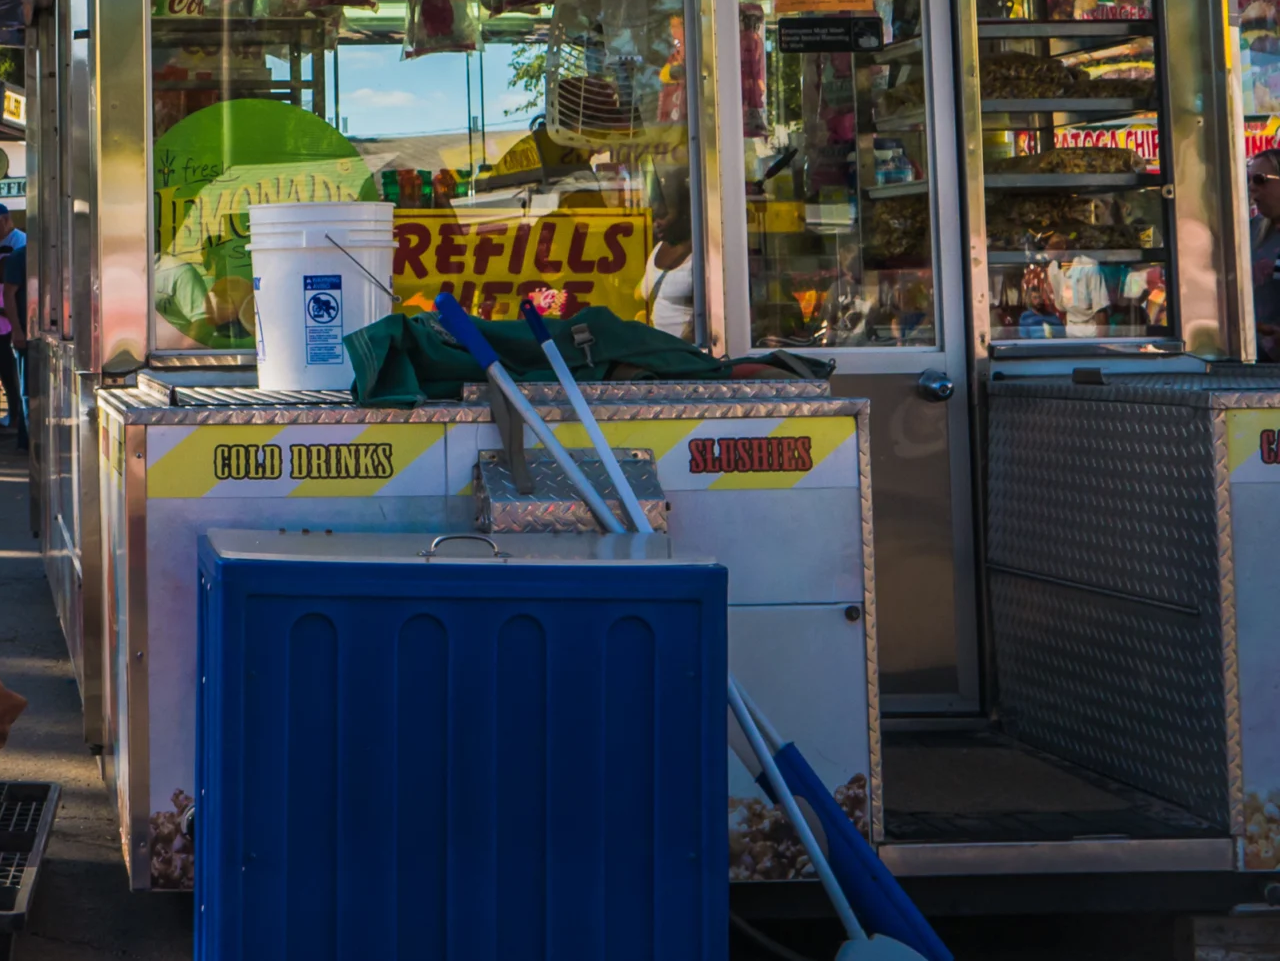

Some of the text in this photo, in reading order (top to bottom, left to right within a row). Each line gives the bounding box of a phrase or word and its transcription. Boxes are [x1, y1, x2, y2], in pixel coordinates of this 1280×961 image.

[182, 157, 233, 181] fresh
[393, 221, 634, 279] REFILLS
[214, 443, 394, 480] COLD DRINKS
[689, 436, 813, 473] SLUSHIES
